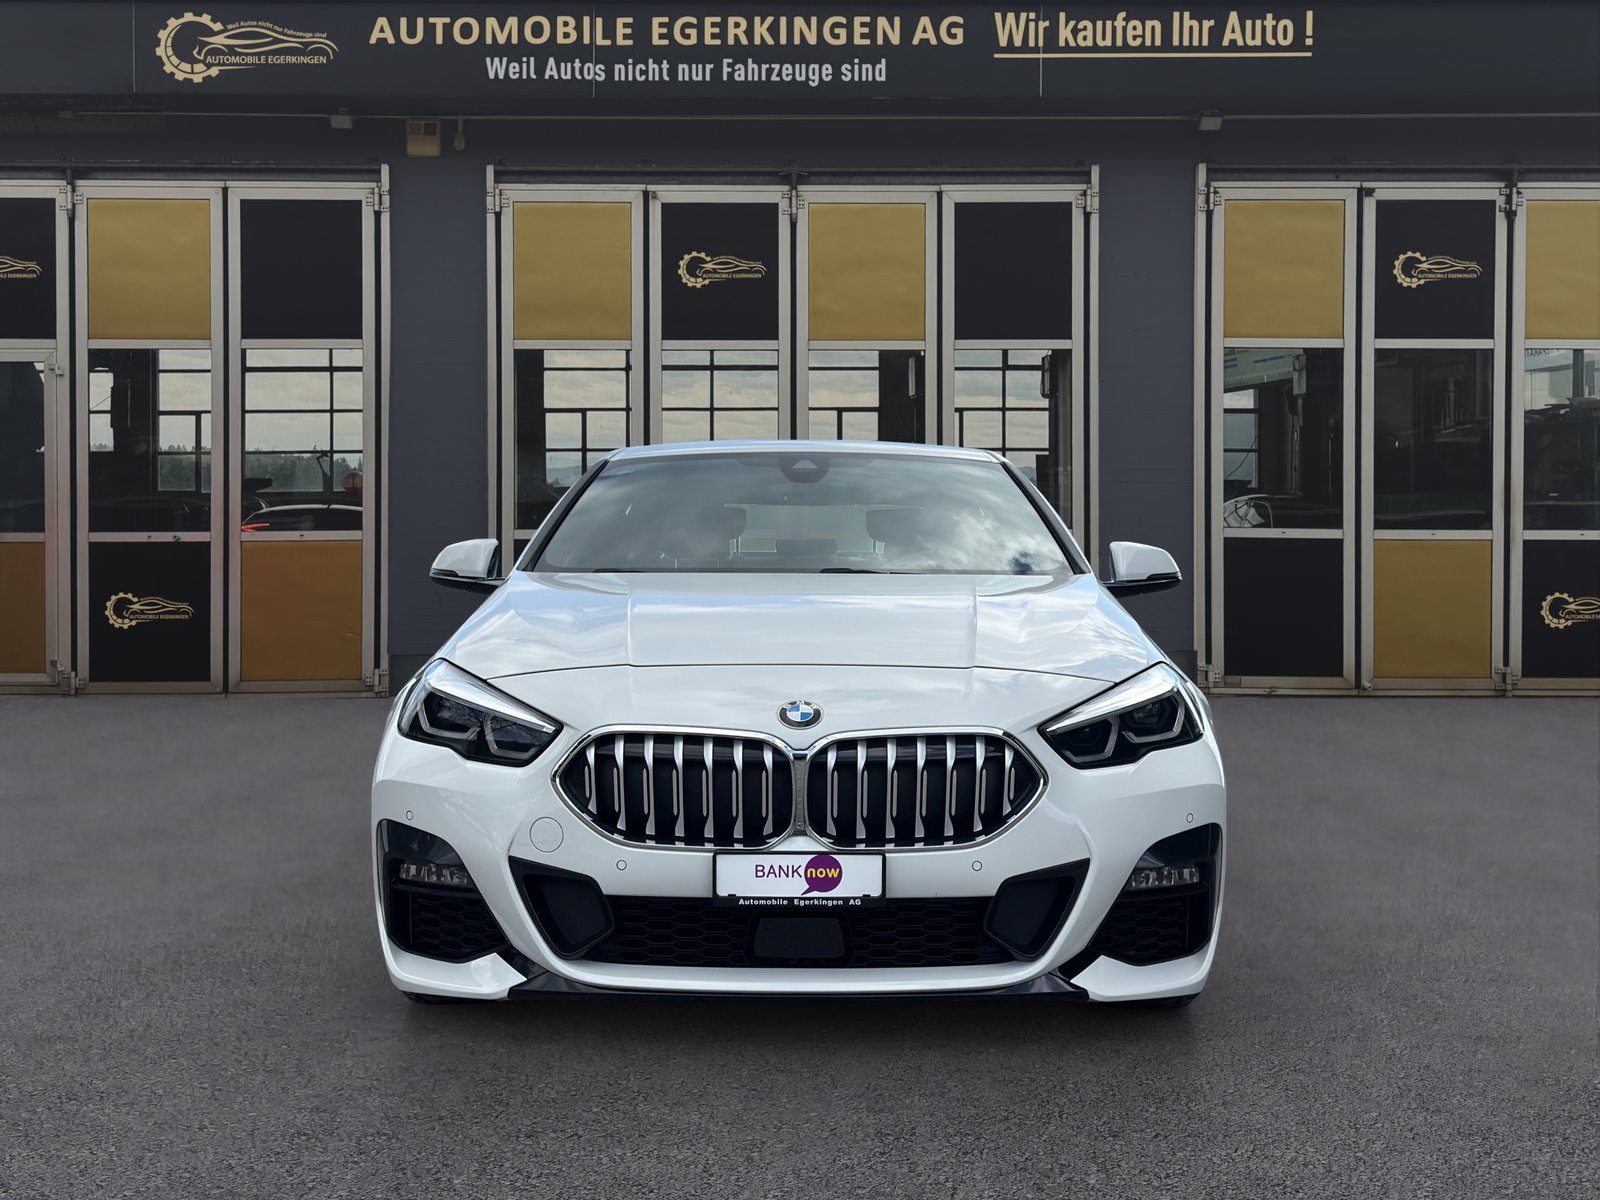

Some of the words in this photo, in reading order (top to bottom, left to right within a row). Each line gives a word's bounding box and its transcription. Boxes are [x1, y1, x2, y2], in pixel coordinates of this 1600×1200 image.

[226, 22, 240, 30] Weil
[257, 20, 273, 29] nicht
[283, 28, 313, 38] Fahrzeuge
[369, 15, 634, 46] AUTOMOBILE
[651, 15, 900, 46] EGERKINGEN
[911, 15, 965, 46] AG
[994, 11, 1049, 47] Wir
[1058, 11, 1162, 47] kaufen
[1172, 10, 1215, 47] Ihr
[1222, 10, 1294, 47] Auto
[1305, 10, 1314, 46] !
[206, 55, 266, 64] AUTOMOBILE
[268, 55, 327, 64] EGERKINGEN
[485, 57, 536, 80] Weil
[544, 57, 606, 81] Autos
[614, 58, 670, 82] nicht
[677, 62, 714, 81] nur
[722, 58, 833, 87] Fahrzeuge
[840, 58, 887, 82] sind
[755, 864, 802, 878] BANK
[807, 867, 840, 879] now
[739, 898, 788, 906] Automobile
[794, 898, 843, 907] Egerkingen
[849, 898, 862, 906] AG
